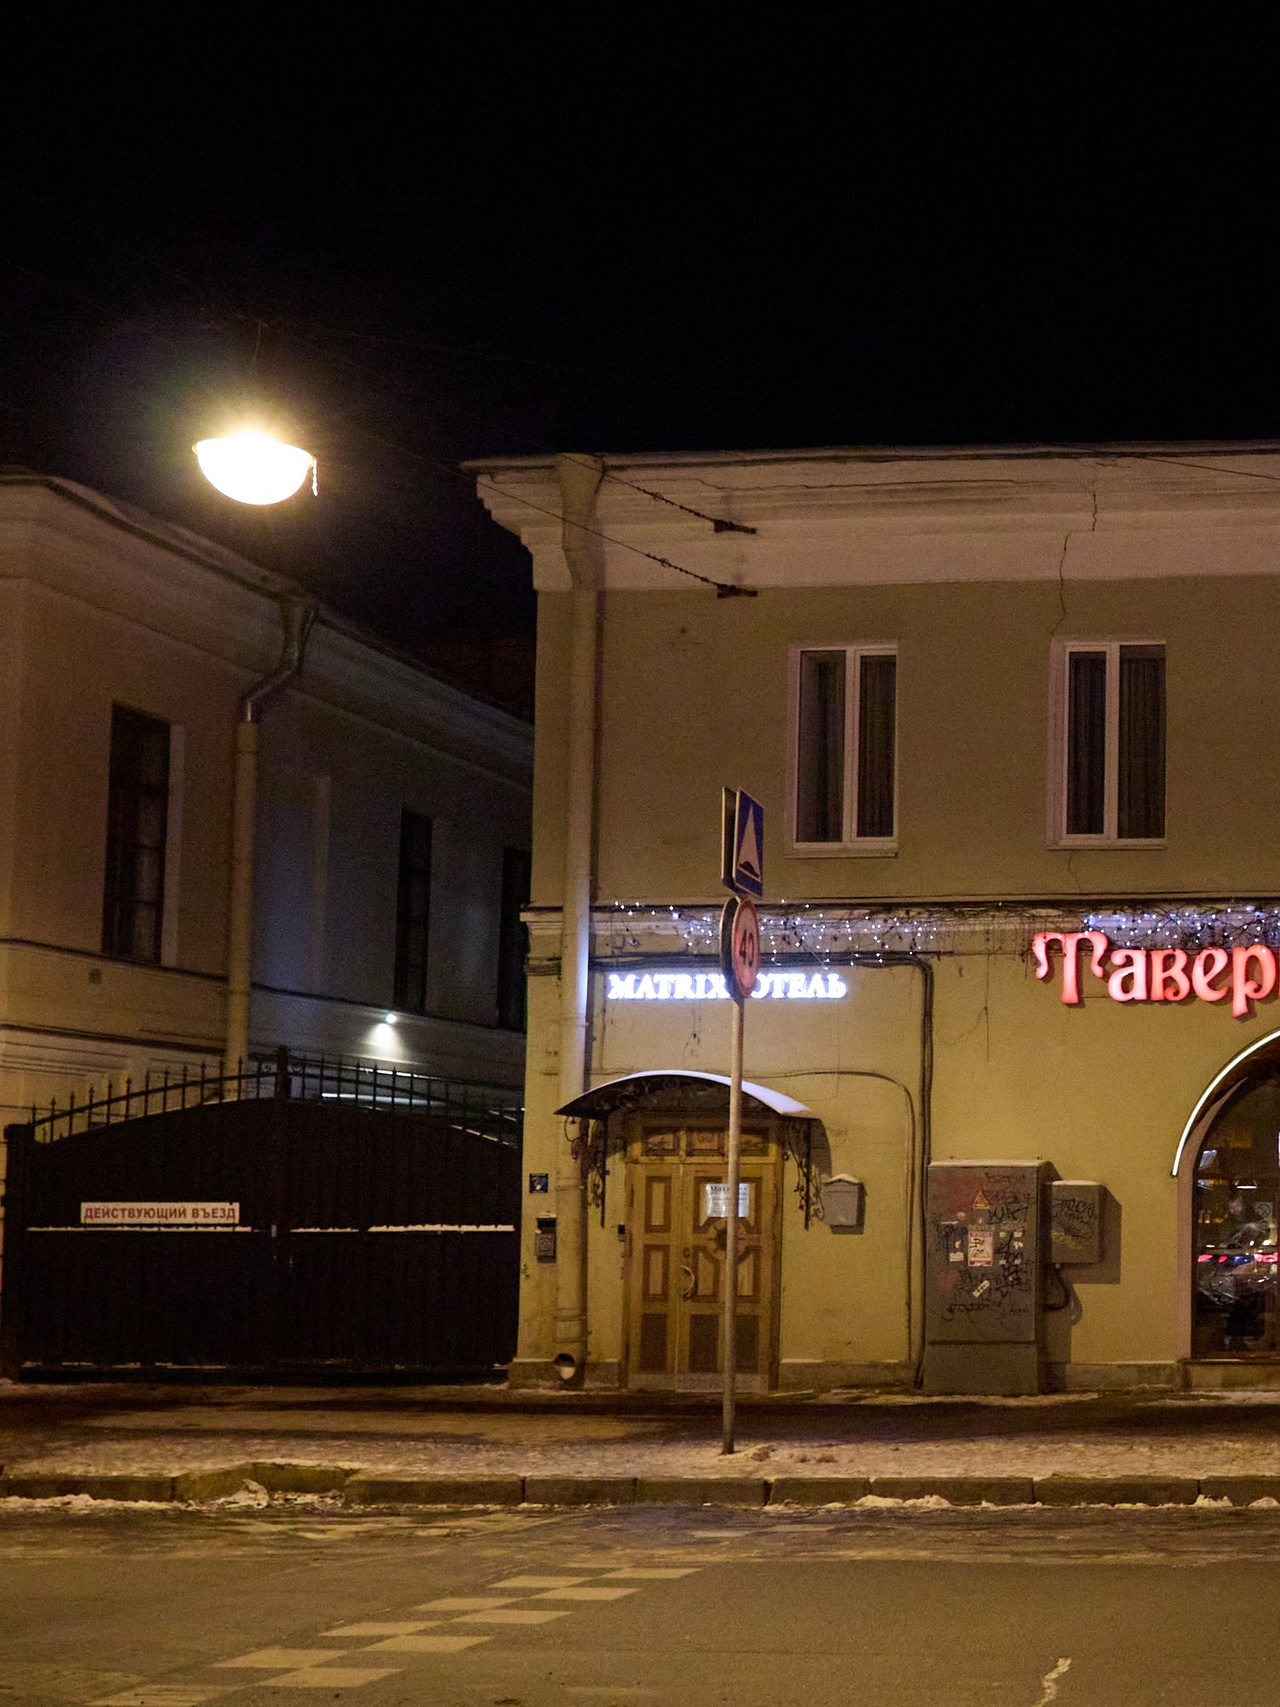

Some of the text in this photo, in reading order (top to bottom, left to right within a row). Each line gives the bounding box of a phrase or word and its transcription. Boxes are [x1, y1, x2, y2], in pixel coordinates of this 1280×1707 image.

[739, 928, 754, 967] 40
[608, 974, 730, 999] MATRIX
[84, 1207, 236, 1219] ДЕЙСТВУЮЩИЙ ВЪЕЗД
